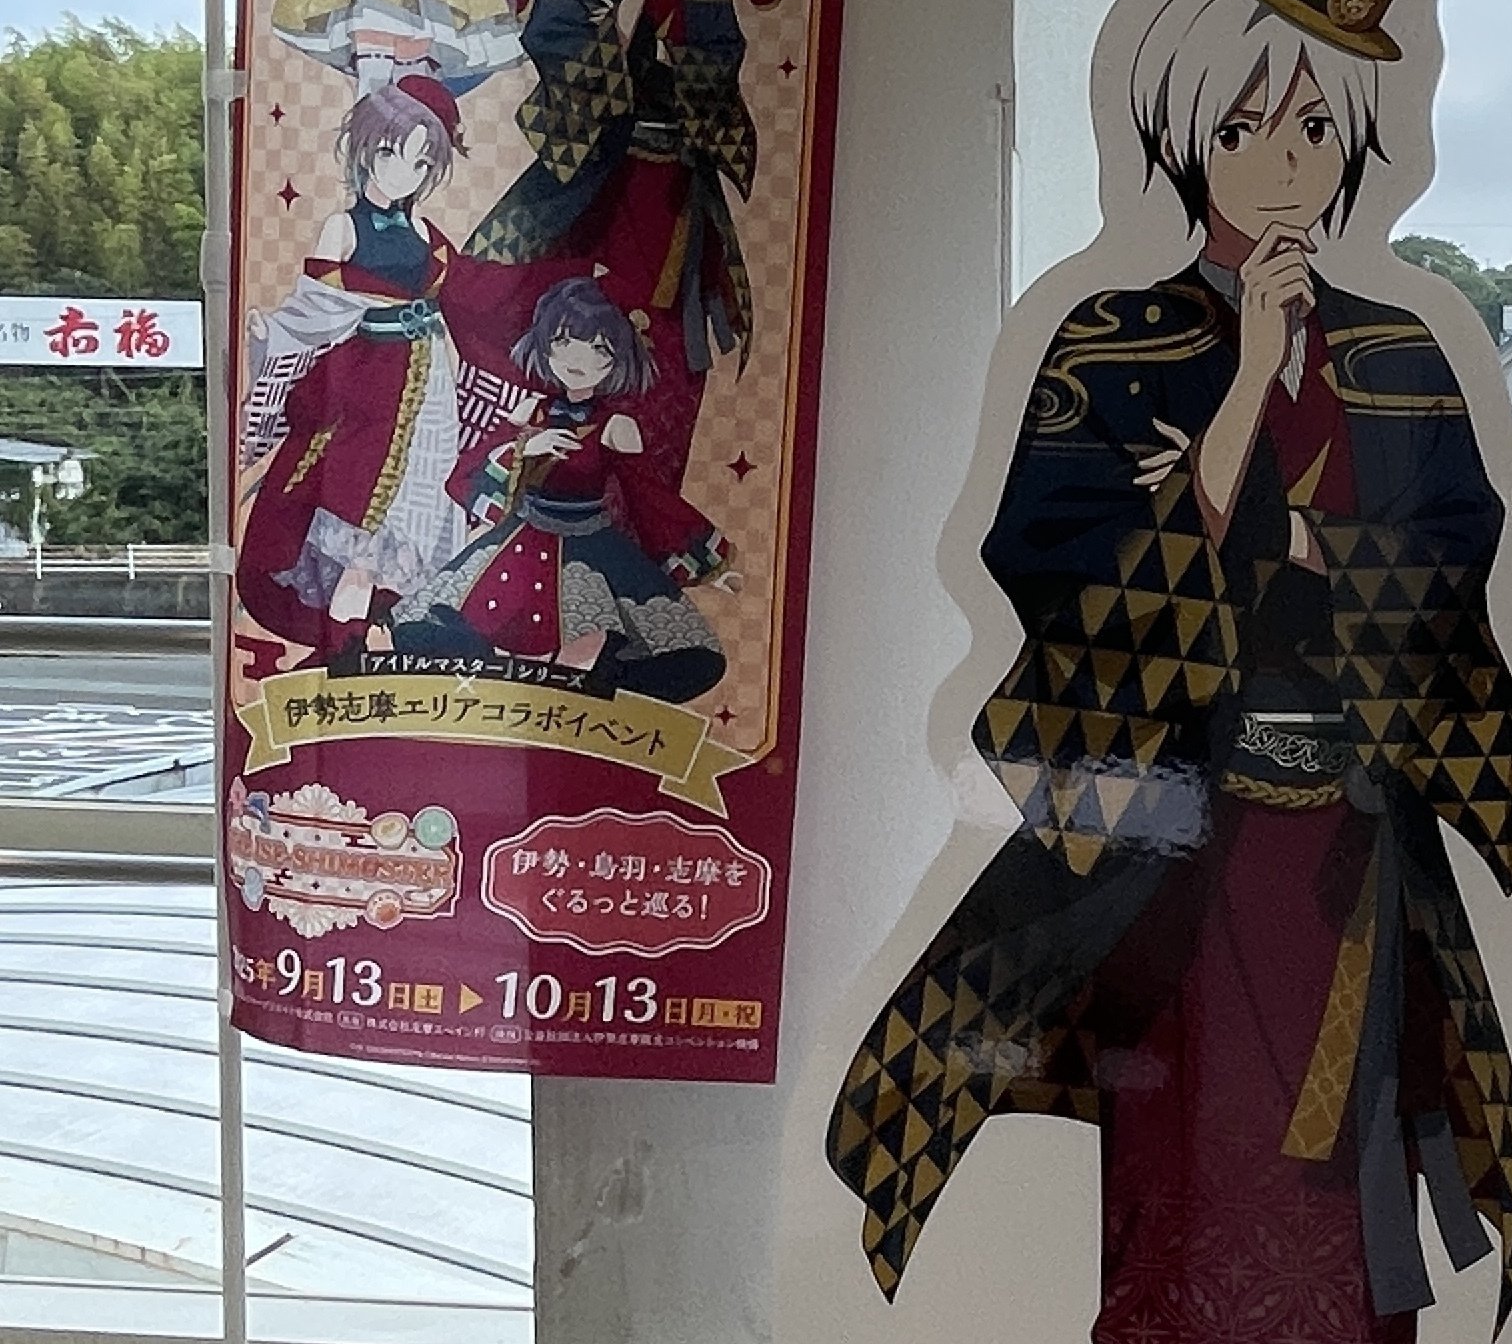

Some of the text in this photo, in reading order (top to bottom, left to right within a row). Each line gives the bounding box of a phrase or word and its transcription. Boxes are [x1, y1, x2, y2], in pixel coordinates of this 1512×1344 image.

[285, 690, 667, 756] 伊勢志摩エリアコラボイベント
